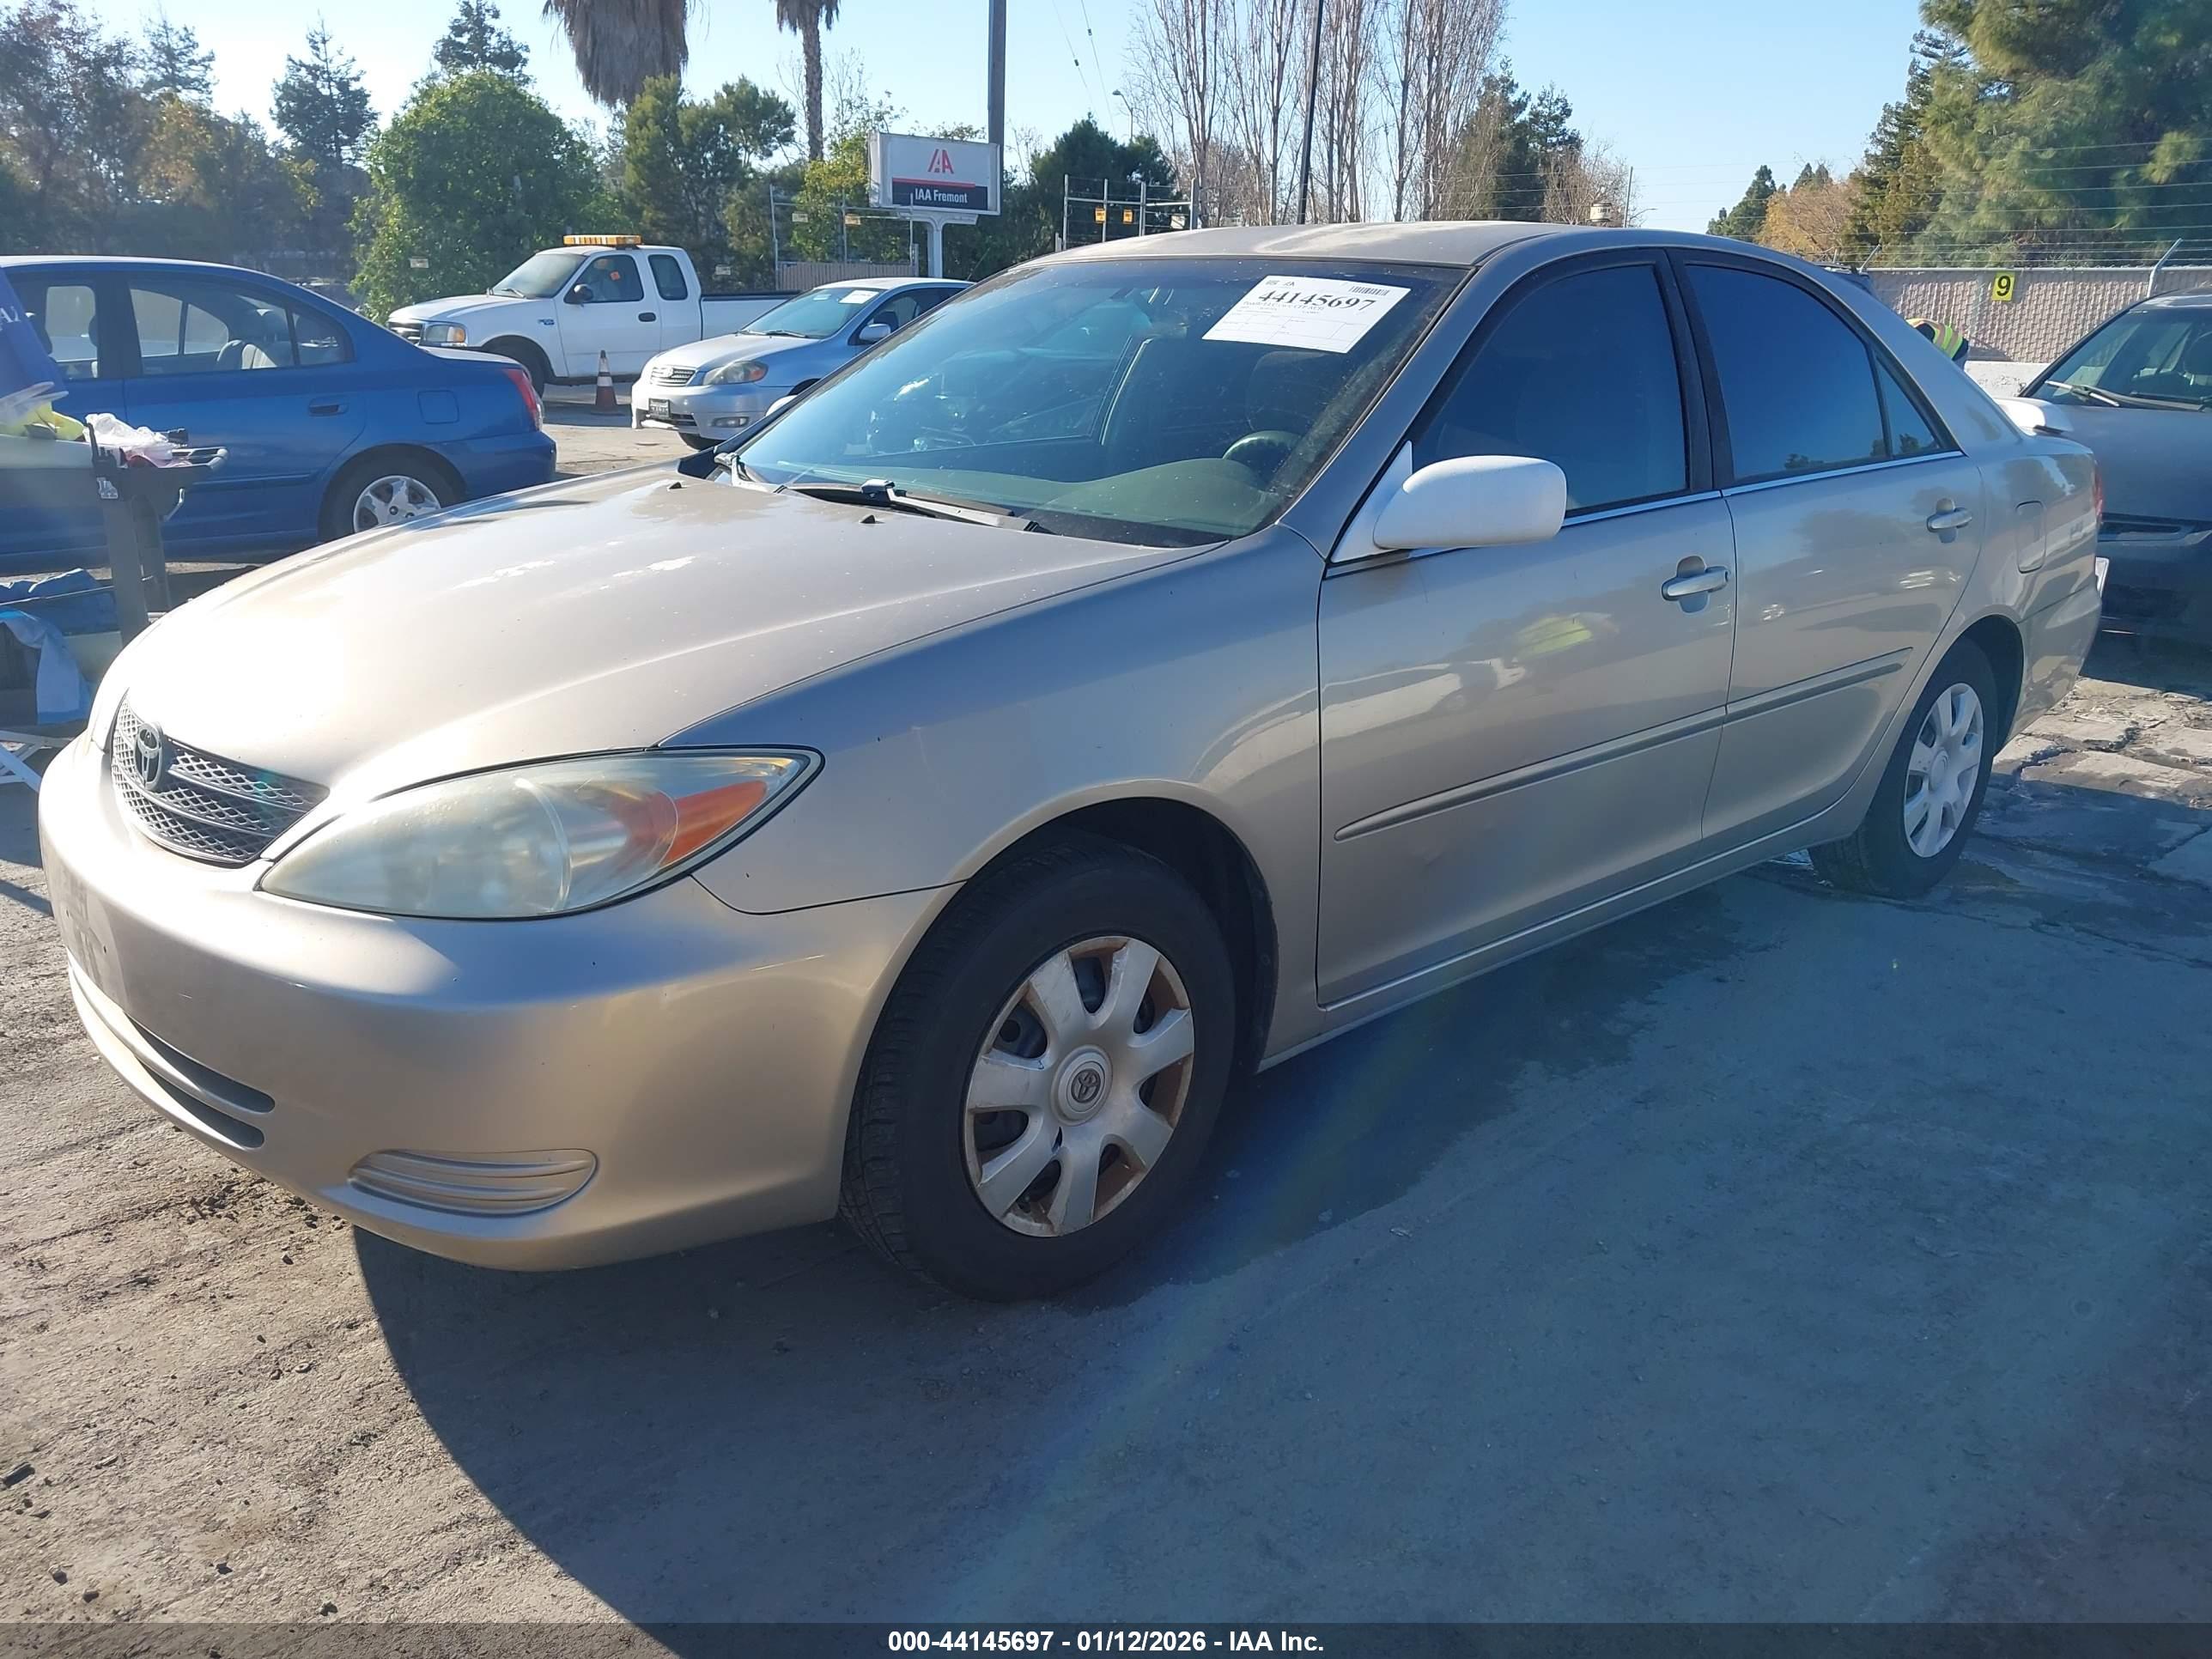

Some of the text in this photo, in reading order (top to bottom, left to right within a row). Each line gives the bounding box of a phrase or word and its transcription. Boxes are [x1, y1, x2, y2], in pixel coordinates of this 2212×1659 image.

[915, 187, 969, 204] IAA Fremont
[1996, 275, 2011, 297] 9
[1258, 289, 1377, 312] 44145697
